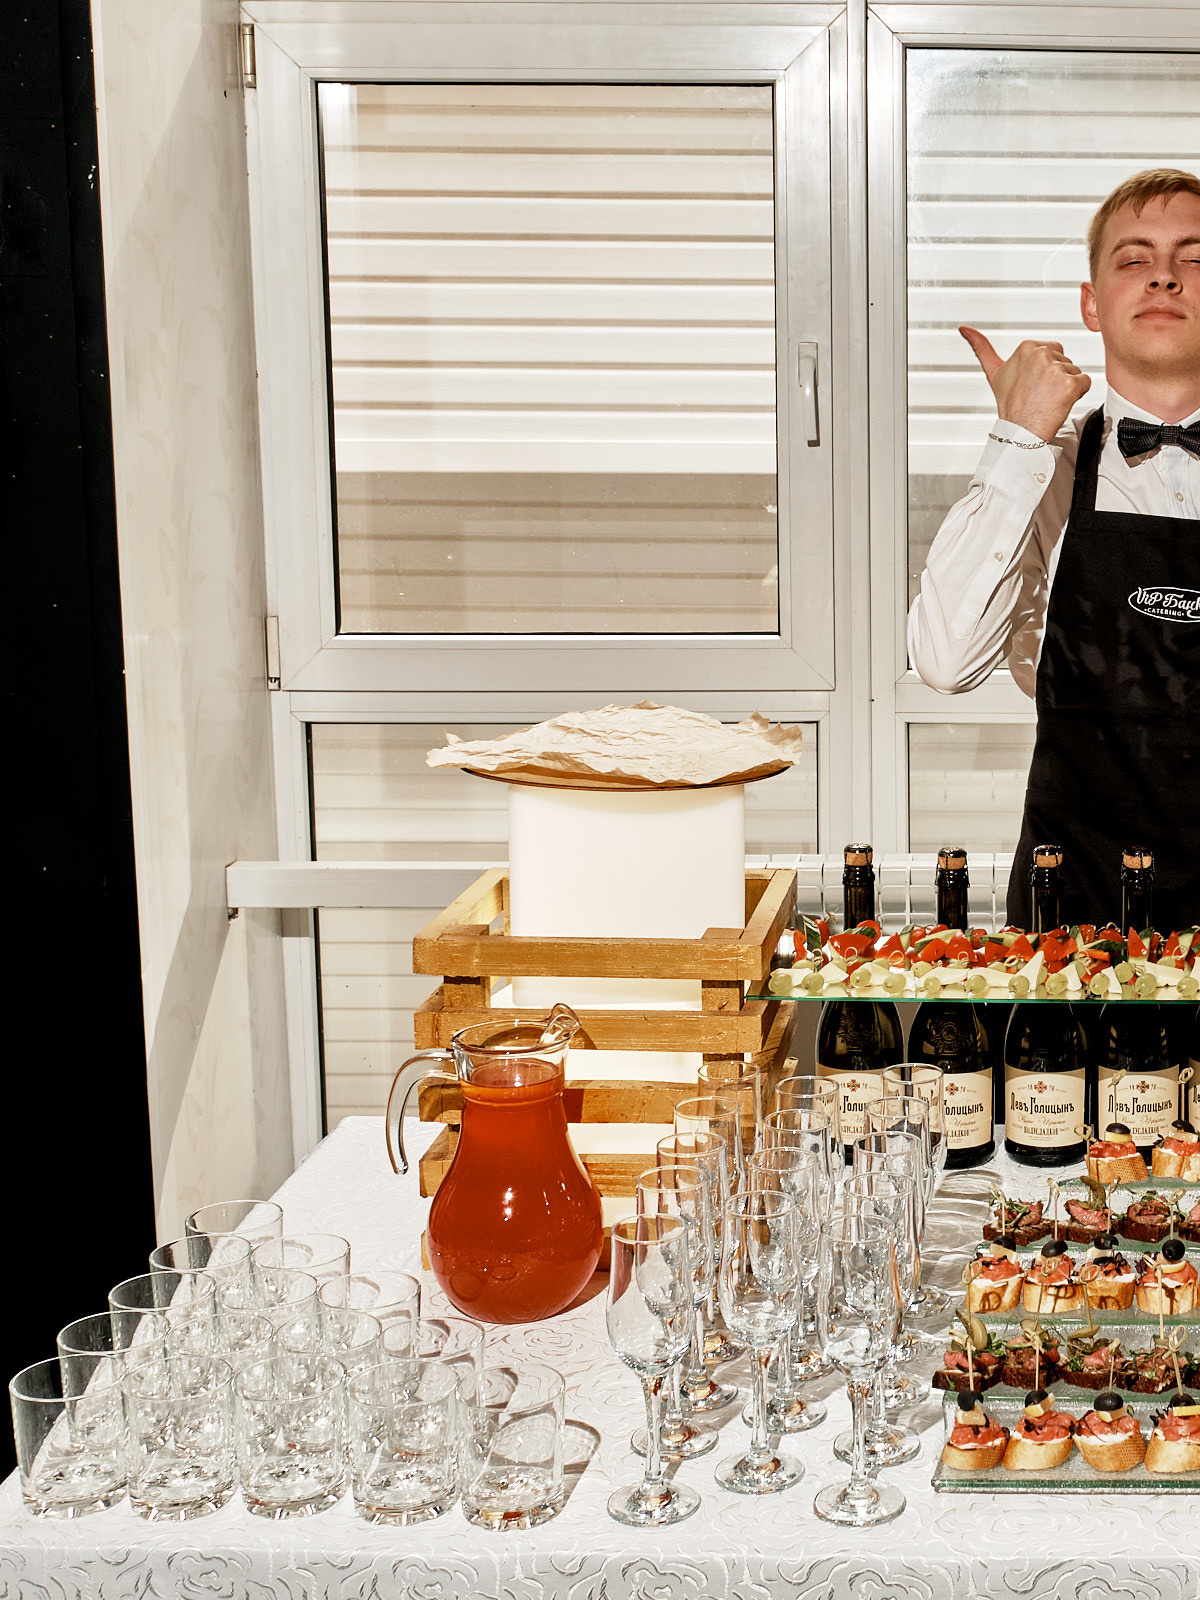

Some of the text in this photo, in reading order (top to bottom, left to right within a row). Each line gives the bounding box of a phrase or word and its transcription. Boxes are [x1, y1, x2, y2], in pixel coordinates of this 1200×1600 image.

[1146, 607, 1182, 617] CATERING
[943, 1100, 984, 1116] олицынъ
[1010, 1092, 1075, 1115] Левъ Голицынъ
[1131, 1097, 1173, 1115] Голицынъ
